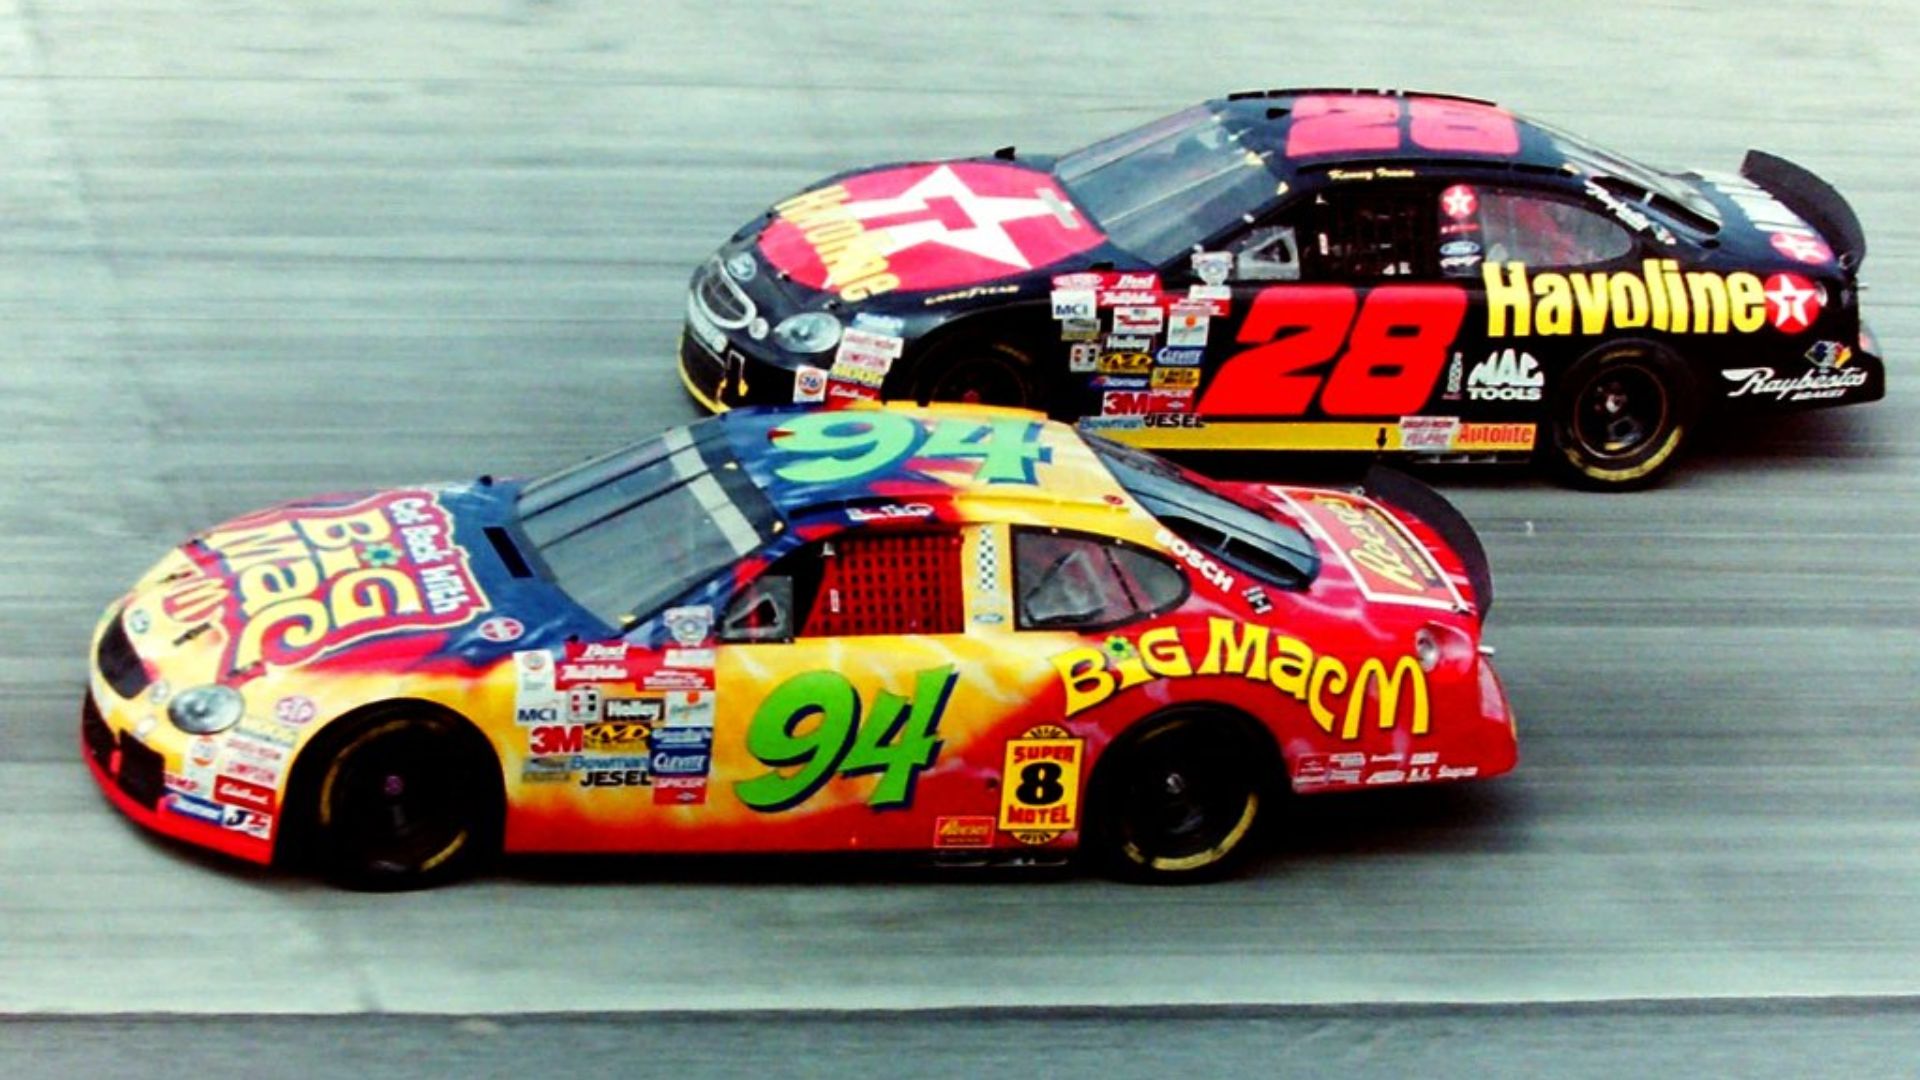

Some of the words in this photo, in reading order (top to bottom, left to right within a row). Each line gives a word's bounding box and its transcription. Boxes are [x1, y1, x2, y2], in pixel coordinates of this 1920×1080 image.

[1055, 304, 1088, 316] MCI
[1482, 258, 1767, 338] Havoline
[1195, 284, 1470, 415] 28
[1467, 348, 1545, 386] MAC
[1466, 387, 1542, 401] TOOLS
[1721, 367, 1868, 400] Raybestos
[1104, 393, 1148, 415] 3M
[770, 411, 1051, 485] 94
[1155, 528, 1234, 593] BOSCH
[518, 708, 557, 721] MCI
[530, 725, 584, 755] 3M
[734, 663, 960, 813] 94
[1014, 746, 1075, 763] SUPER
[580, 770, 653, 786] JESEL
[1015, 761, 1064, 805] 8
[1008, 804, 1070, 824] MOTEL
